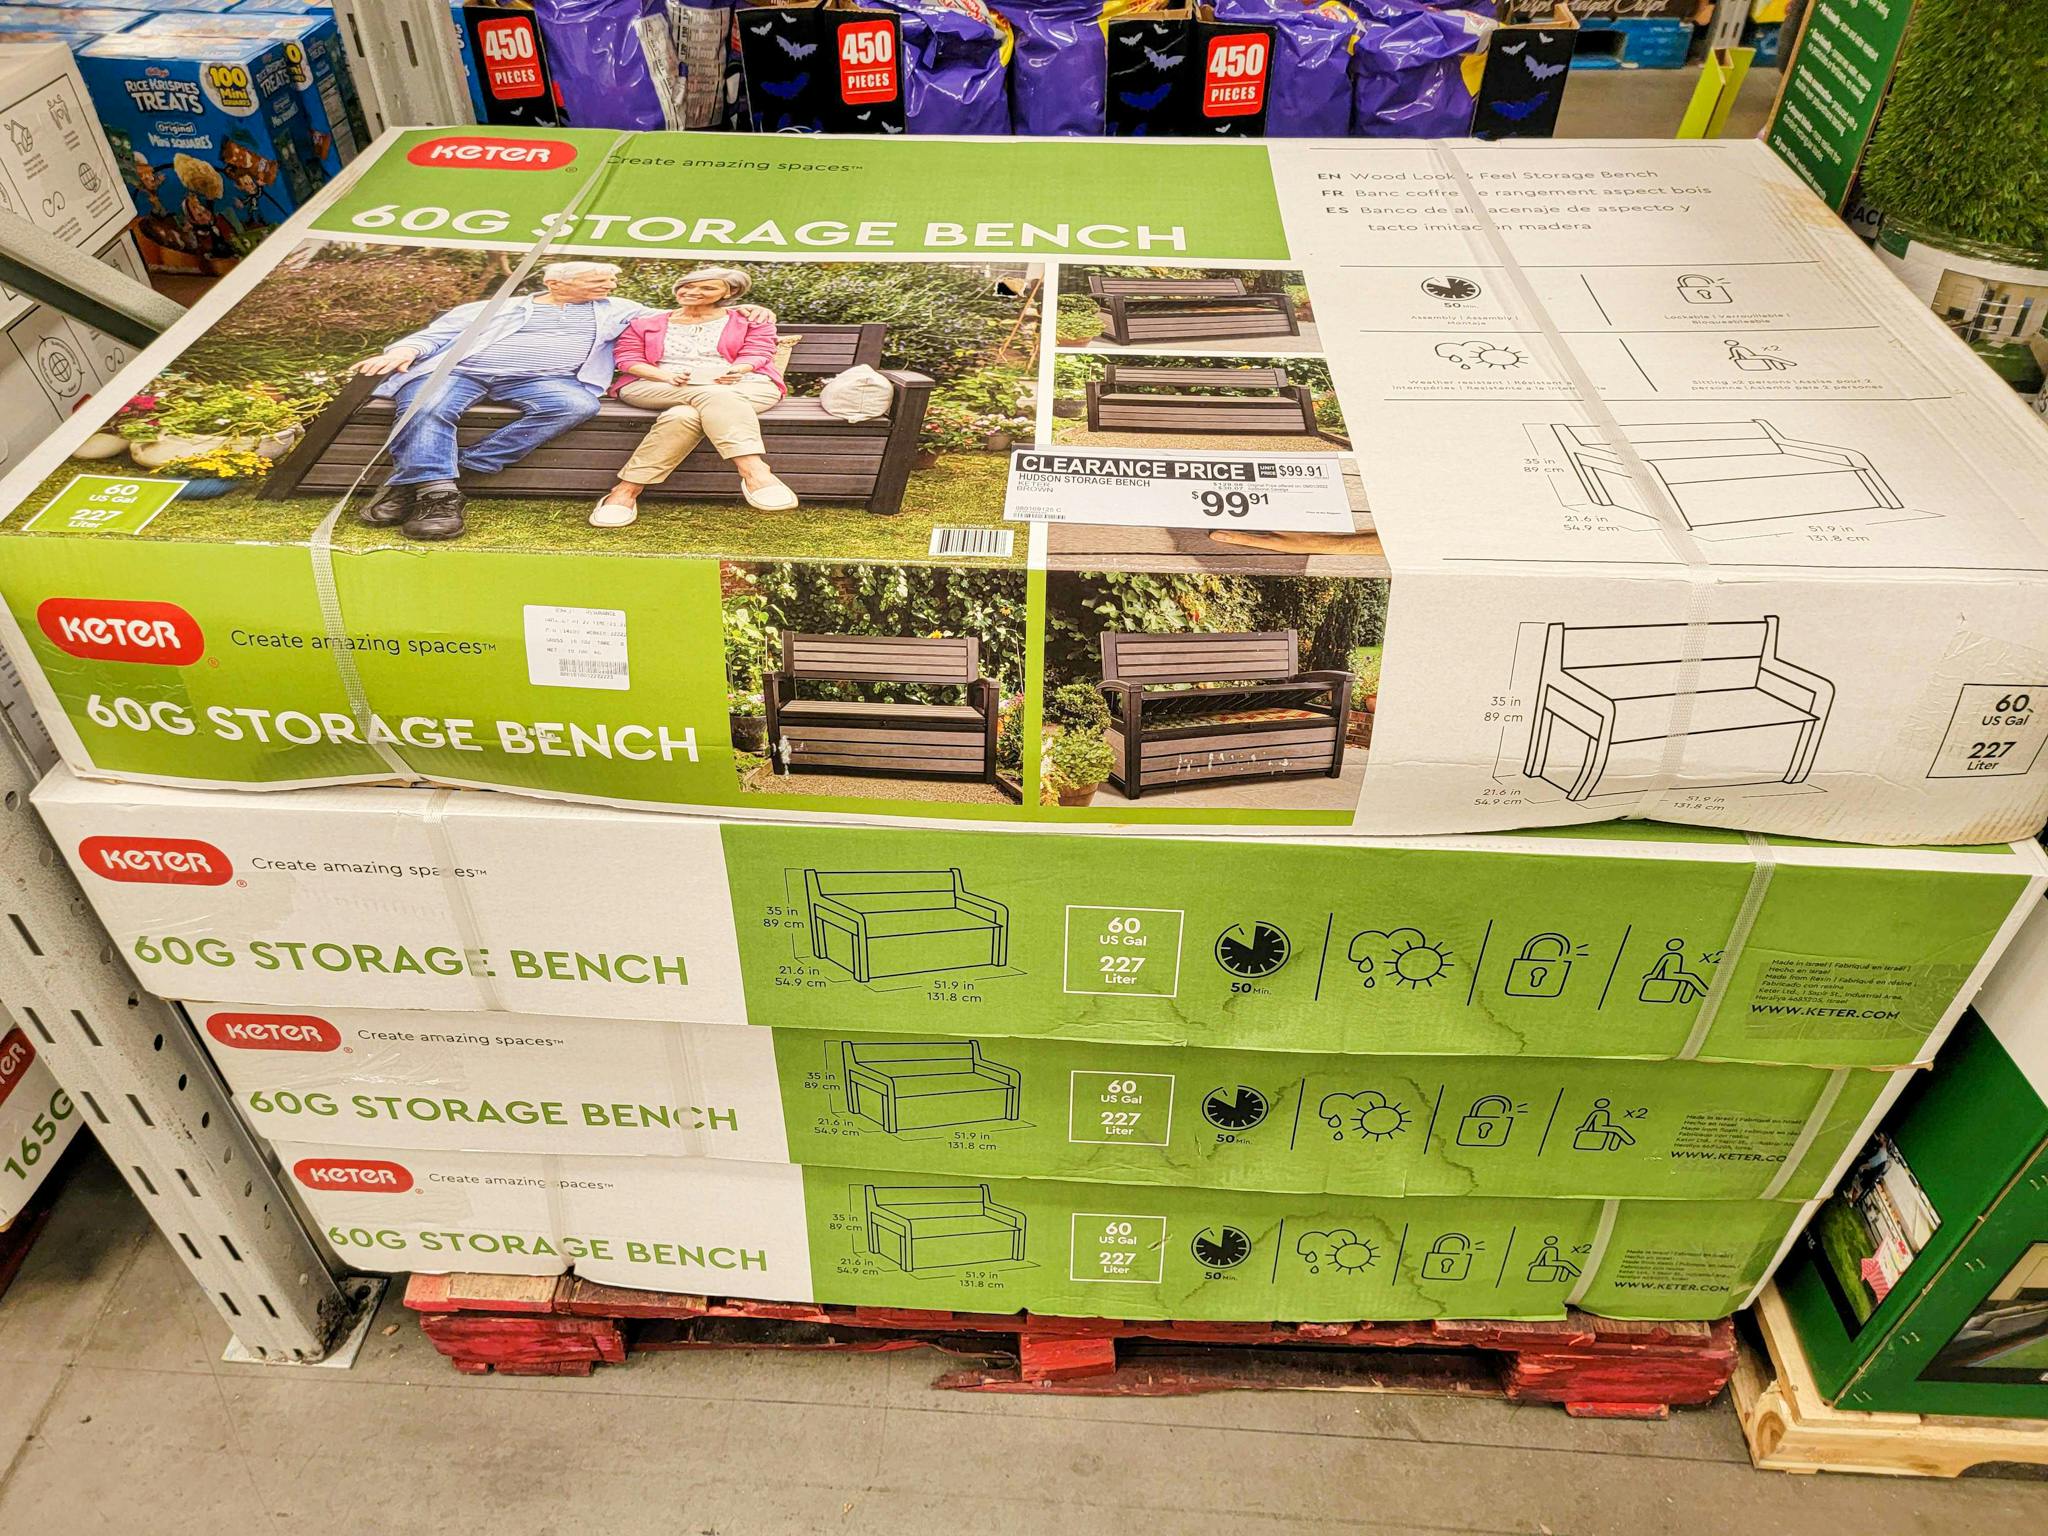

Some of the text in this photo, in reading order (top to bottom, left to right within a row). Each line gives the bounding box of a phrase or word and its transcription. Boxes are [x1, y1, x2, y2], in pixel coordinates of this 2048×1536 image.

[485, 27, 533, 60] 450
[842, 30, 891, 64] 450
[1209, 44, 1264, 78] 450
[209, 65, 247, 87] 100
[495, 69, 535, 85] PIECES
[848, 73, 889, 88] PIECES
[125, 79, 199, 94] RICE KRISPIES
[1211, 86, 1255, 101] PIECES
[131, 92, 204, 114] TREATS
[158, 123, 193, 133] Original
[430, 142, 550, 164] KETER
[608, 154, 675, 168] Create
[682, 156, 770, 174] amazing
[1351, 172, 1406, 180] Wood
[1413, 172, 1456, 180] Look
[1480, 172, 1516, 180] Feel
[1523, 171, 1594, 181] Storage
[1600, 170, 1658, 179] Bench
[1356, 189, 1400, 197] Banc
[1406, 189, 1458, 197] coffre
[1496, 188, 1597, 198] rangement
[1603, 187, 1665, 197] aspect
[1671, 186, 1712, 195] bois
[1425, 206, 1447, 214] de
[1567, 205, 1591, 213] de
[1598, 204, 1674, 213] aspecto
[351, 204, 1187, 251] 60G STORAGE BENCH
[1520, 222, 1591, 231] madera
[1022, 456, 1245, 480] CLEARANCE PRICE
[1279, 465, 1323, 477] $99.91
[1019, 473, 1150, 487] HUDSON STORAGE BENCH
[105, 484, 140, 496] 60
[89, 494, 138, 504] US Gal
[70, 509, 123, 521] 227
[68, 520, 102, 530] Liter
[58, 616, 181, 649] KETER
[231, 630, 304, 649] Create
[312, 633, 400, 655] amazing
[1491, 696, 1521, 707] 35 in
[1995, 695, 2029, 713] 60
[1484, 711, 1523, 722] 89 cm
[1982, 714, 2029, 726] US Gal
[87, 694, 699, 762] 60G STORAGE BENCH
[1967, 741, 2016, 760] 227
[1967, 760, 1999, 771] Liter
[1483, 788, 1505, 796] 21.6
[1475, 798, 1499, 806] 54.9
[1687, 795, 1709, 803] 51.9
[1673, 801, 1702, 810] 131.8
[100, 850, 212, 873] KETER
[251, 857, 317, 872] Create
[323, 861, 402, 877] amazing
[766, 906, 799, 916] 35 in
[763, 919, 781, 928] 89
[1108, 917, 1140, 934] 60
[1099, 935, 1147, 946] US Gal
[134, 936, 688, 986] 60G STORAGE BENCH
[1099, 956, 1146, 973] 227
[779, 966, 820, 975] 21.6 in
[775, 978, 826, 988] 54.9 cm
[1104, 974, 1137, 985] Liter
[934, 981, 974, 991] 51.9 in
[1230, 983, 1252, 993] 50
[927, 992, 982, 1003] 131.8 cm
[1751, 1004, 1900, 1019] WWW.KETER.COM
[225, 1023, 323, 1042] KETER
[358, 1030, 415, 1041] Create
[421, 1033, 490, 1046] amazing
[1108, 1080, 1137, 1093] 60
[1101, 1094, 1142, 1104] US Gal
[250, 1091, 738, 1131] 60G STORAGE BENCH
[1624, 1108, 1648, 1120] x2
[1101, 1112, 1141, 1126] 227
[4, 1088, 74, 1180] 165G
[1105, 1126, 1133, 1136] Liter
[1216, 1134, 1235, 1143] 50
[310, 1167, 397, 1184] KETER
[429, 1173, 479, 1184] Create
[1106, 1222, 1132, 1235] 60
[1099, 1236, 1136, 1245] US Gal
[328, 1227, 767, 1272] 60G STORAGE BENCH
[1571, 1244, 1592, 1254] x2
[1099, 1252, 1136, 1265] 227
[1104, 1266, 1130, 1274] Liter
[1204, 1272, 1221, 1280] 50
[1615, 1281, 1730, 1293] WWW.KETER.COM
